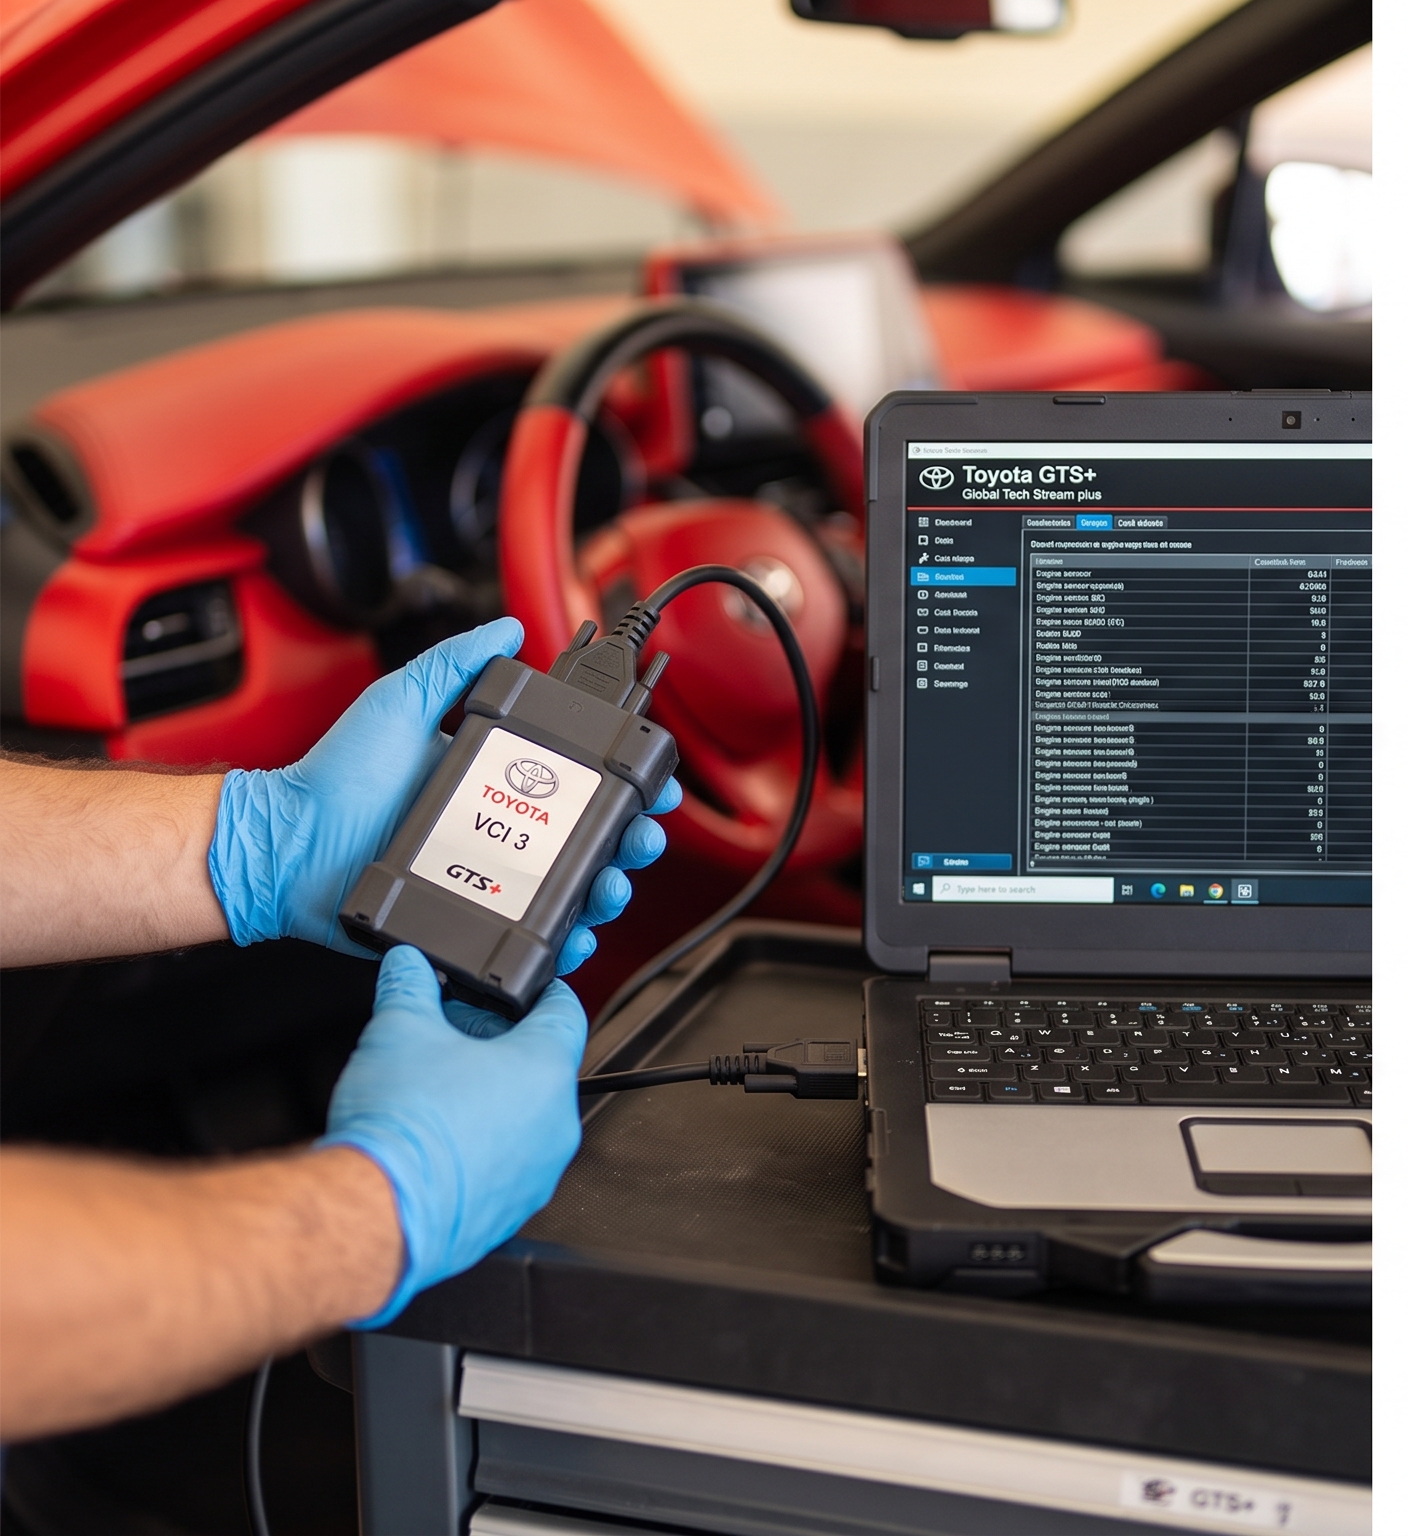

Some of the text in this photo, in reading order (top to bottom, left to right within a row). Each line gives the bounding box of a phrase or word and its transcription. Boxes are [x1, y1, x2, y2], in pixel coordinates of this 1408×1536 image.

[962, 465, 1097, 487] Toyota GTS+
[1002, 488, 1030, 500] Tech
[1033, 488, 1075, 500] Stream
[483, 785, 549, 825] TOYOTA
[474, 812, 530, 850] VCI 3
[446, 864, 501, 894] GTS+
